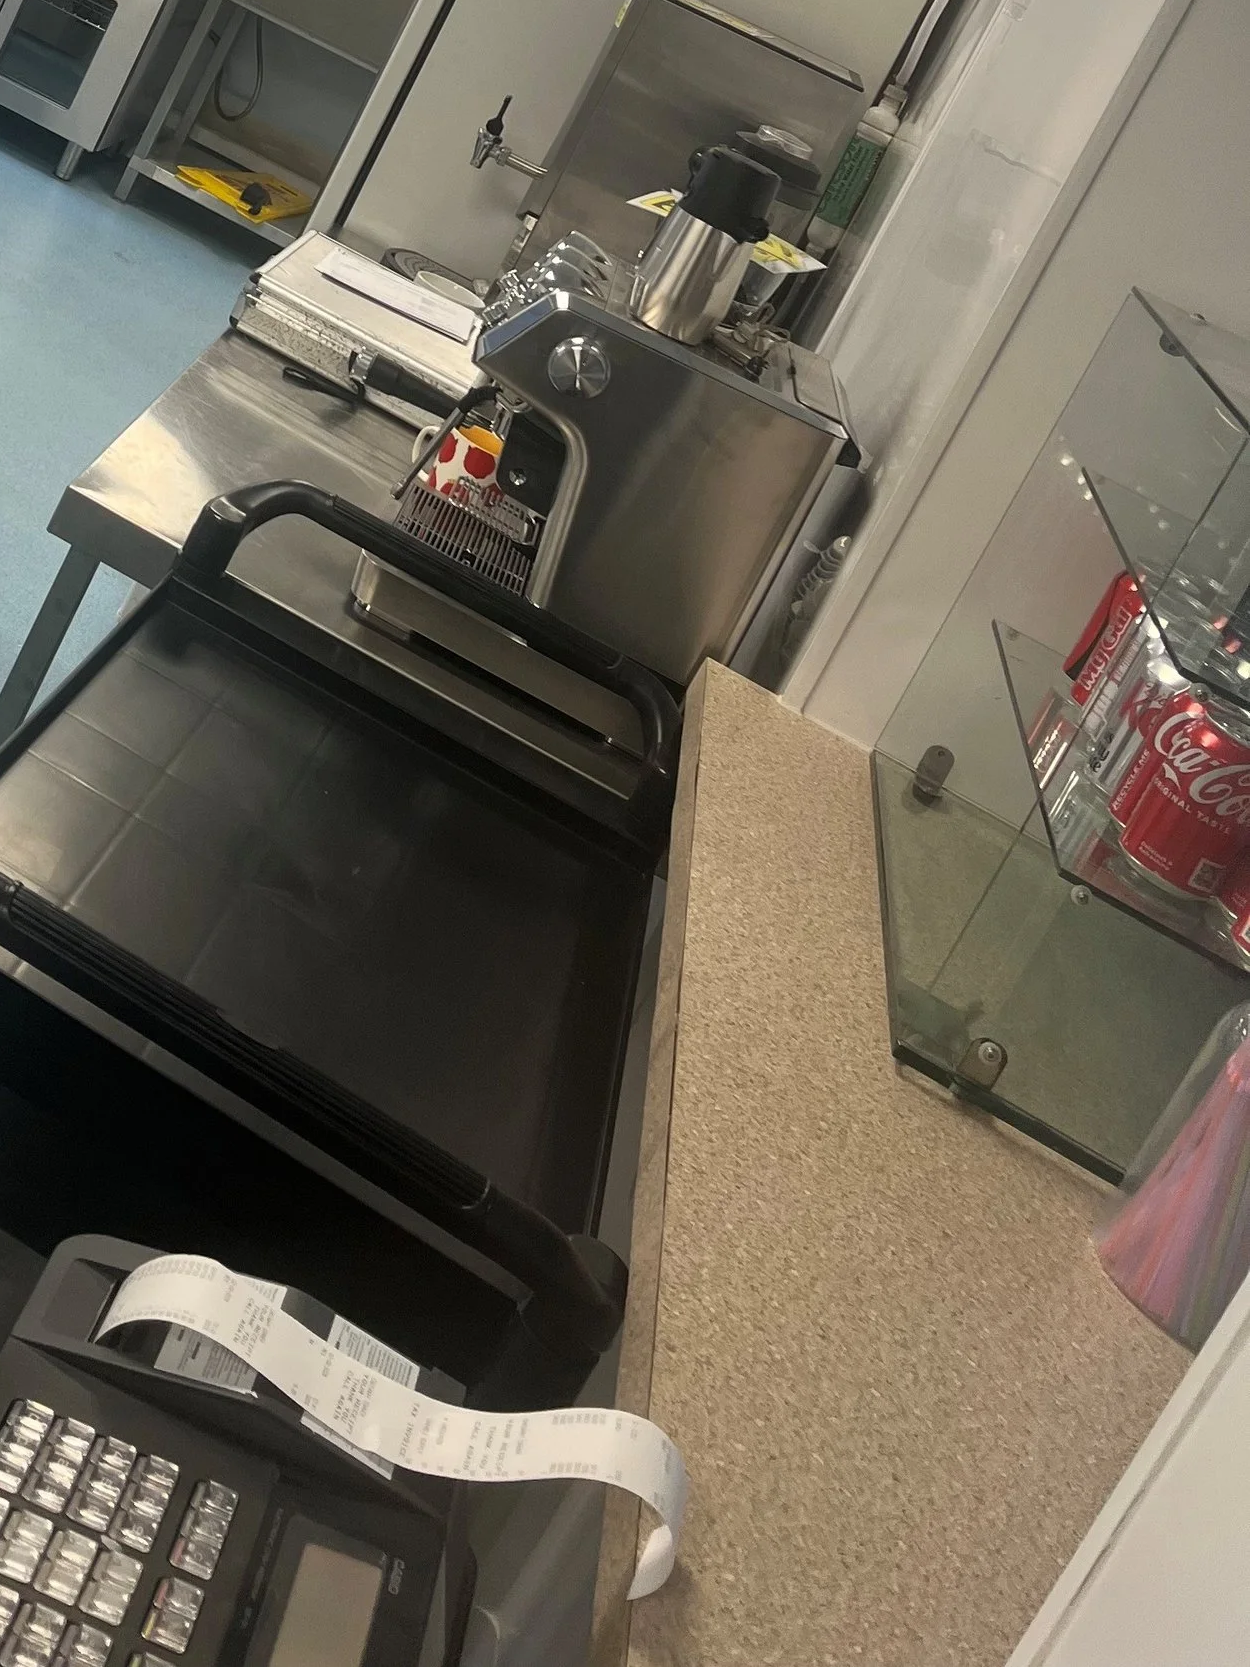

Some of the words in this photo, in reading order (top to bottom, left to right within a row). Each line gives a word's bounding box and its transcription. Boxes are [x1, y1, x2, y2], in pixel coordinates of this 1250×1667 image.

[242, 1296, 254, 1314] CALL
[247, 1305, 259, 1327] THANK
[257, 1304, 268, 1323] YOUR
[232, 1318, 246, 1343] AGAIN
[239, 1331, 249, 1346] YOU
[244, 1324, 261, 1357] RECEIPT
[341, 1370, 353, 1390] CALL
[346, 1377, 358, 1402] THANK
[357, 1373, 369, 1395] YOUR
[332, 1394, 345, 1420] AGAIN
[339, 1406, 350, 1423] YOU
[344, 1398, 361, 1434] RECEIPT
